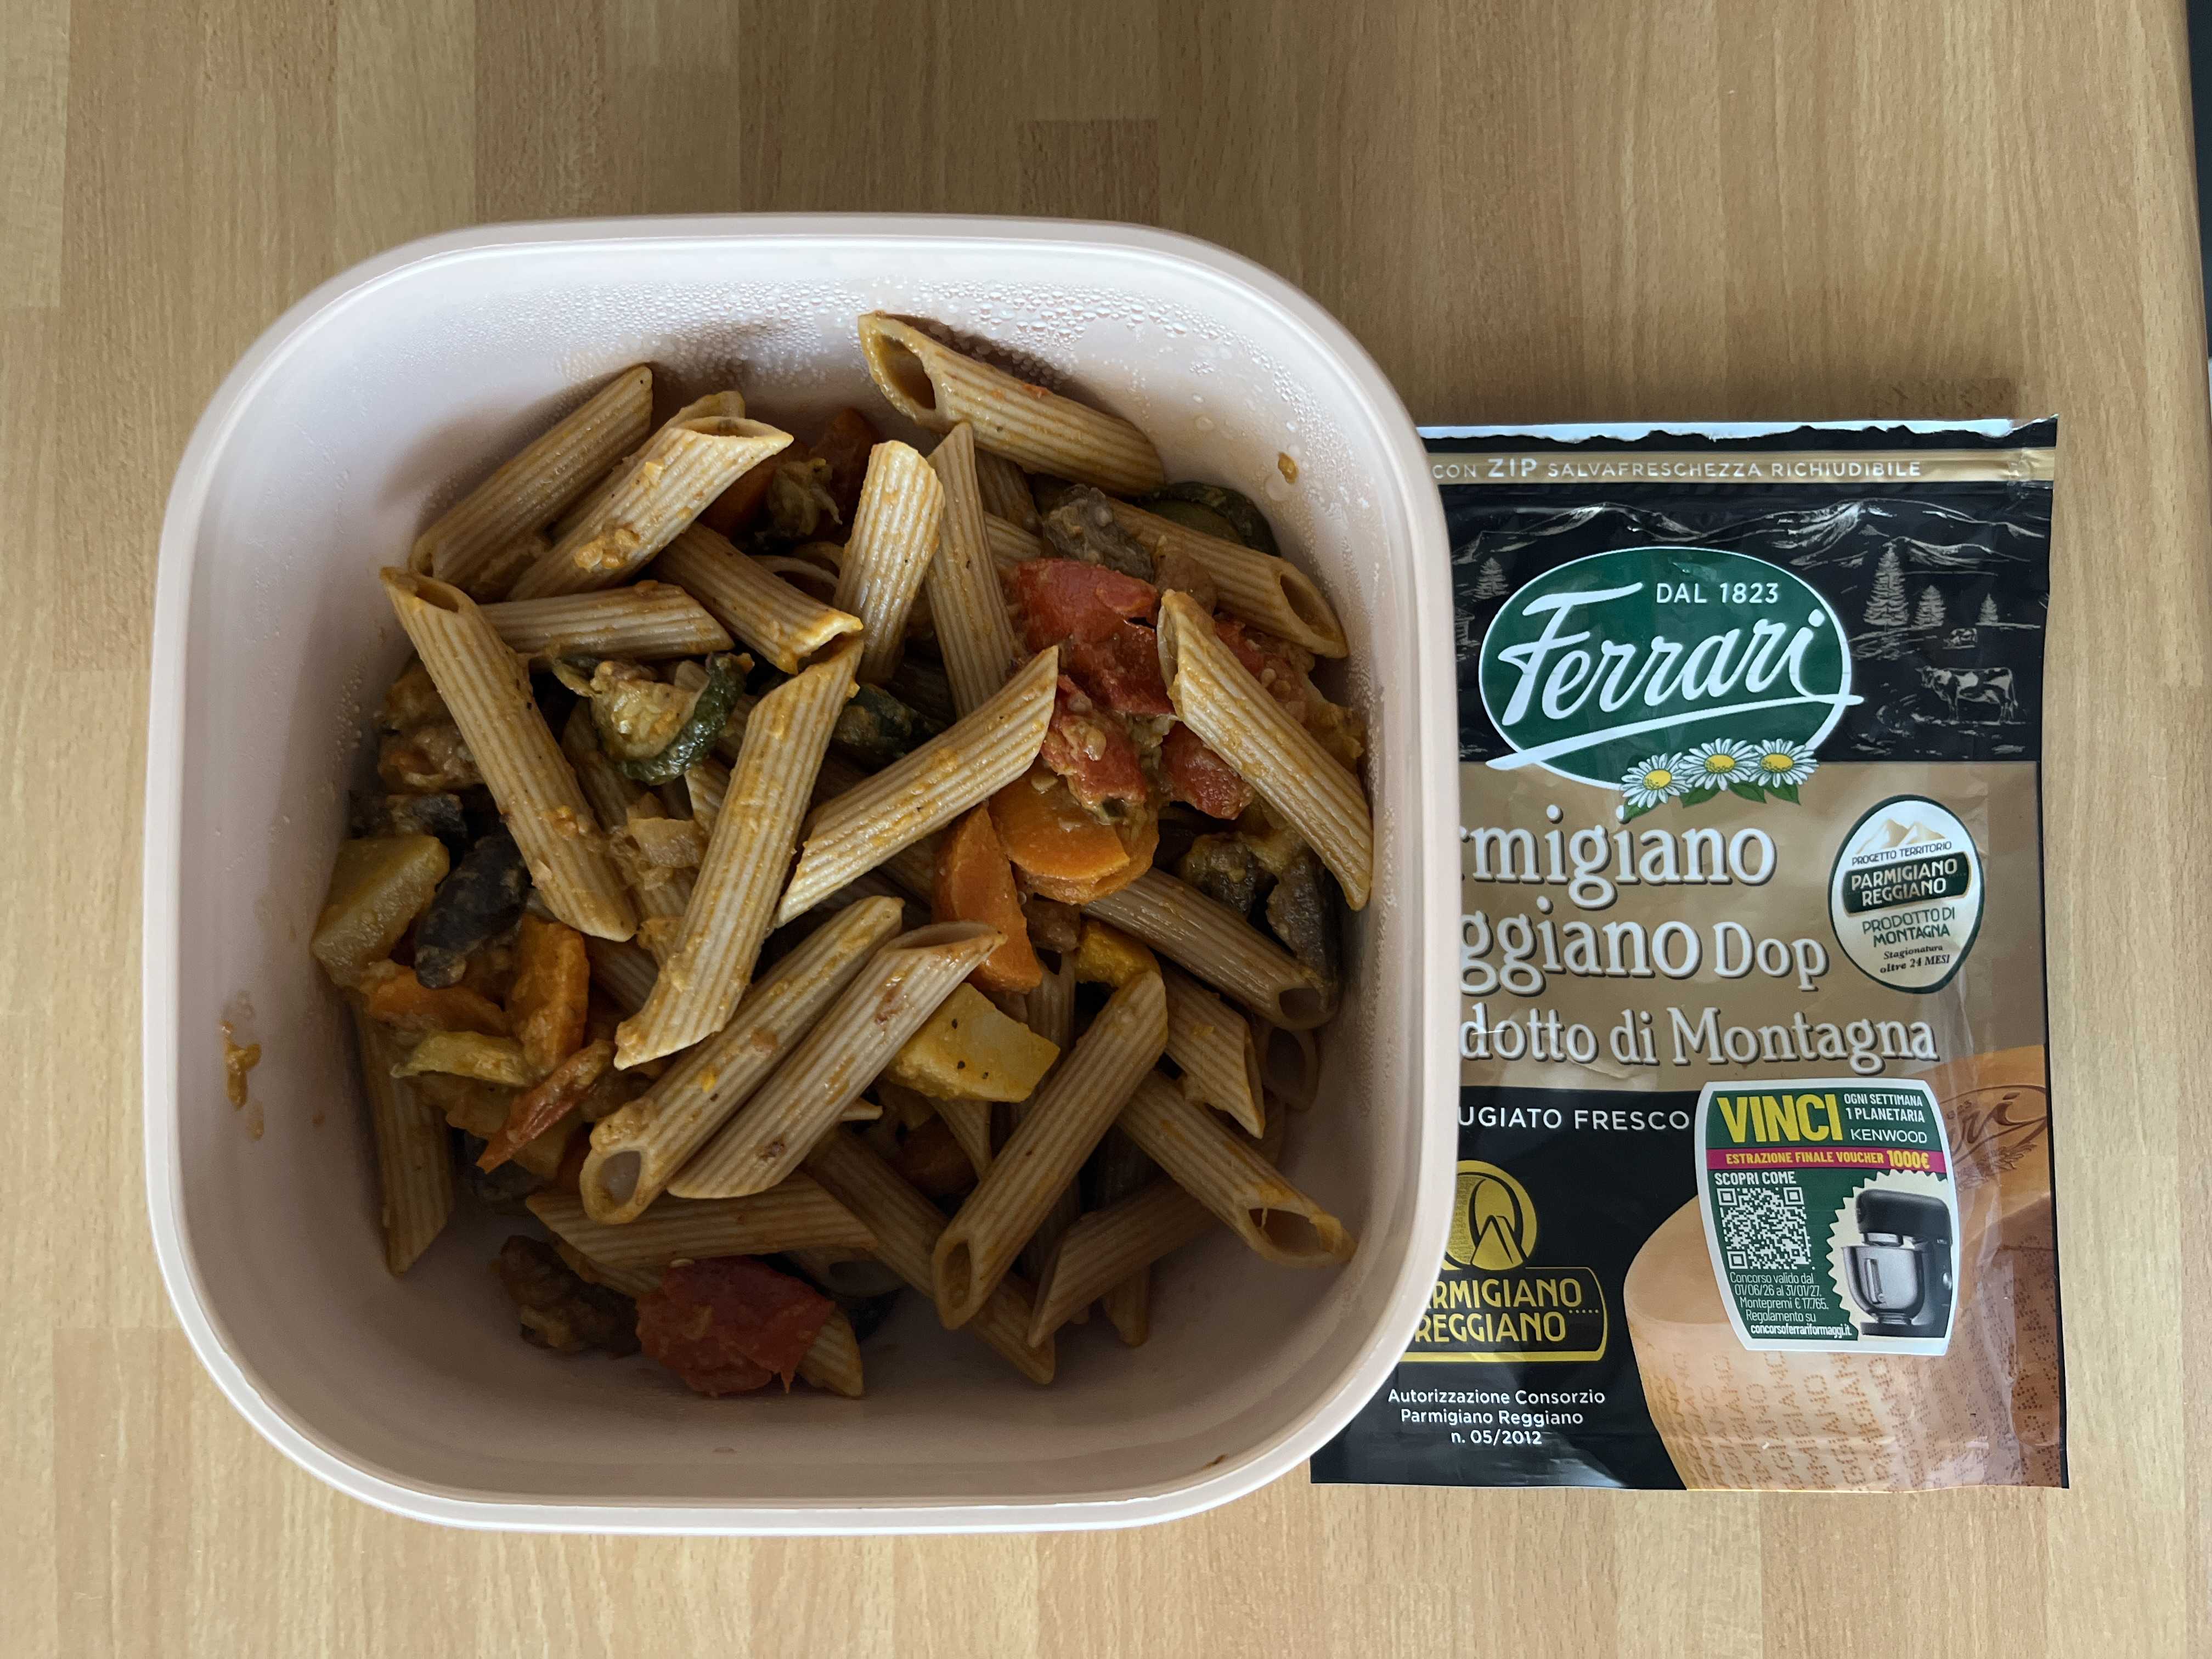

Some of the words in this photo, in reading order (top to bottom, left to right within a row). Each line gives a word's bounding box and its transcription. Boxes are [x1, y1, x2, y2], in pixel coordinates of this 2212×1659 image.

[1431, 464, 1477, 479] CON
[1487, 458, 1537, 477] ZIP
[1547, 462, 1762, 477] SALVAFRESCHEZZA
[1771, 461, 1921, 477] RICHIUDIBILE
[1656, 583, 1708, 603] DAL
[1719, 582, 1779, 603] 1823
[1497, 582, 1864, 727] Ferrari
[1852, 850, 1897, 866] PROGETTO
[1899, 840, 1953, 858] TERRITORIO
[1851, 857, 1958, 891] PARMIGIANO
[1861, 877, 1947, 907] REGGIANO
[1861, 907, 1940, 935] PRODOTTO
[1942, 906, 1955, 921] DI
[1459, 895, 1703, 996] ggiano
[1713, 922, 1829, 991] Dop
[1872, 923, 1951, 948] MONTAGNA
[1883, 944, 1944, 960] Stagionatura
[1880, 962, 1907, 974] oltre
[1909, 957, 1922, 968] 24
[1924, 953, 1950, 966] MESI
[1458, 1002, 1599, 1064] dotto
[1610, 1008, 1660, 1066] di
[1666, 1006, 1940, 1075] Montagna
[1843, 1093, 1869, 1105] OGNI
[1869, 1093, 1923, 1107] SETTIMANA
[1458, 1105, 1562, 1129] UGIATO
[1573, 1110, 1690, 1131] FRESCO
[1716, 1093, 1843, 1143] VINCI
[1846, 1107, 1853, 1120] 1
[1855, 1107, 1925, 1124] PLANETARIA
[1850, 1128, 1927, 1144] KENWOOD
[1725, 1153, 1793, 1165] ESTRAZIONE
[1795, 1152, 1835, 1164] FINALE
[1835, 1152, 1884, 1165] VOUCHER
[1886, 1149, 1931, 1170] 1000€
[1714, 1172, 1759, 1186] SCOPRI
[1762, 1171, 1797, 1185] COME
[1729, 1271, 1772, 1284] Concorso
[1773, 1272, 1799, 1284] valido
[1801, 1273, 1815, 1284] dal
[1426, 1278, 1582, 1309] RMIGIANO
[1776, 1285, 1785, 1296] al
[1739, 1296, 1793, 1311] Montepremi
[1795, 1298, 1802, 1309] €
[1414, 1311, 1566, 1343] REGGIANO
[1746, 1309, 1804, 1324] Regolamento
[1805, 1313, 1816, 1323] su
[1387, 1389, 1510, 1405] Autorizzazione
[1515, 1389, 1606, 1405] Consorzio
[1401, 1408, 1493, 1426] Parmigiano
[1498, 1410, 1584, 1427] Reggiano
[1451, 1432, 1466, 1444] n.
[1470, 1429, 1543, 1446] 05/2012
